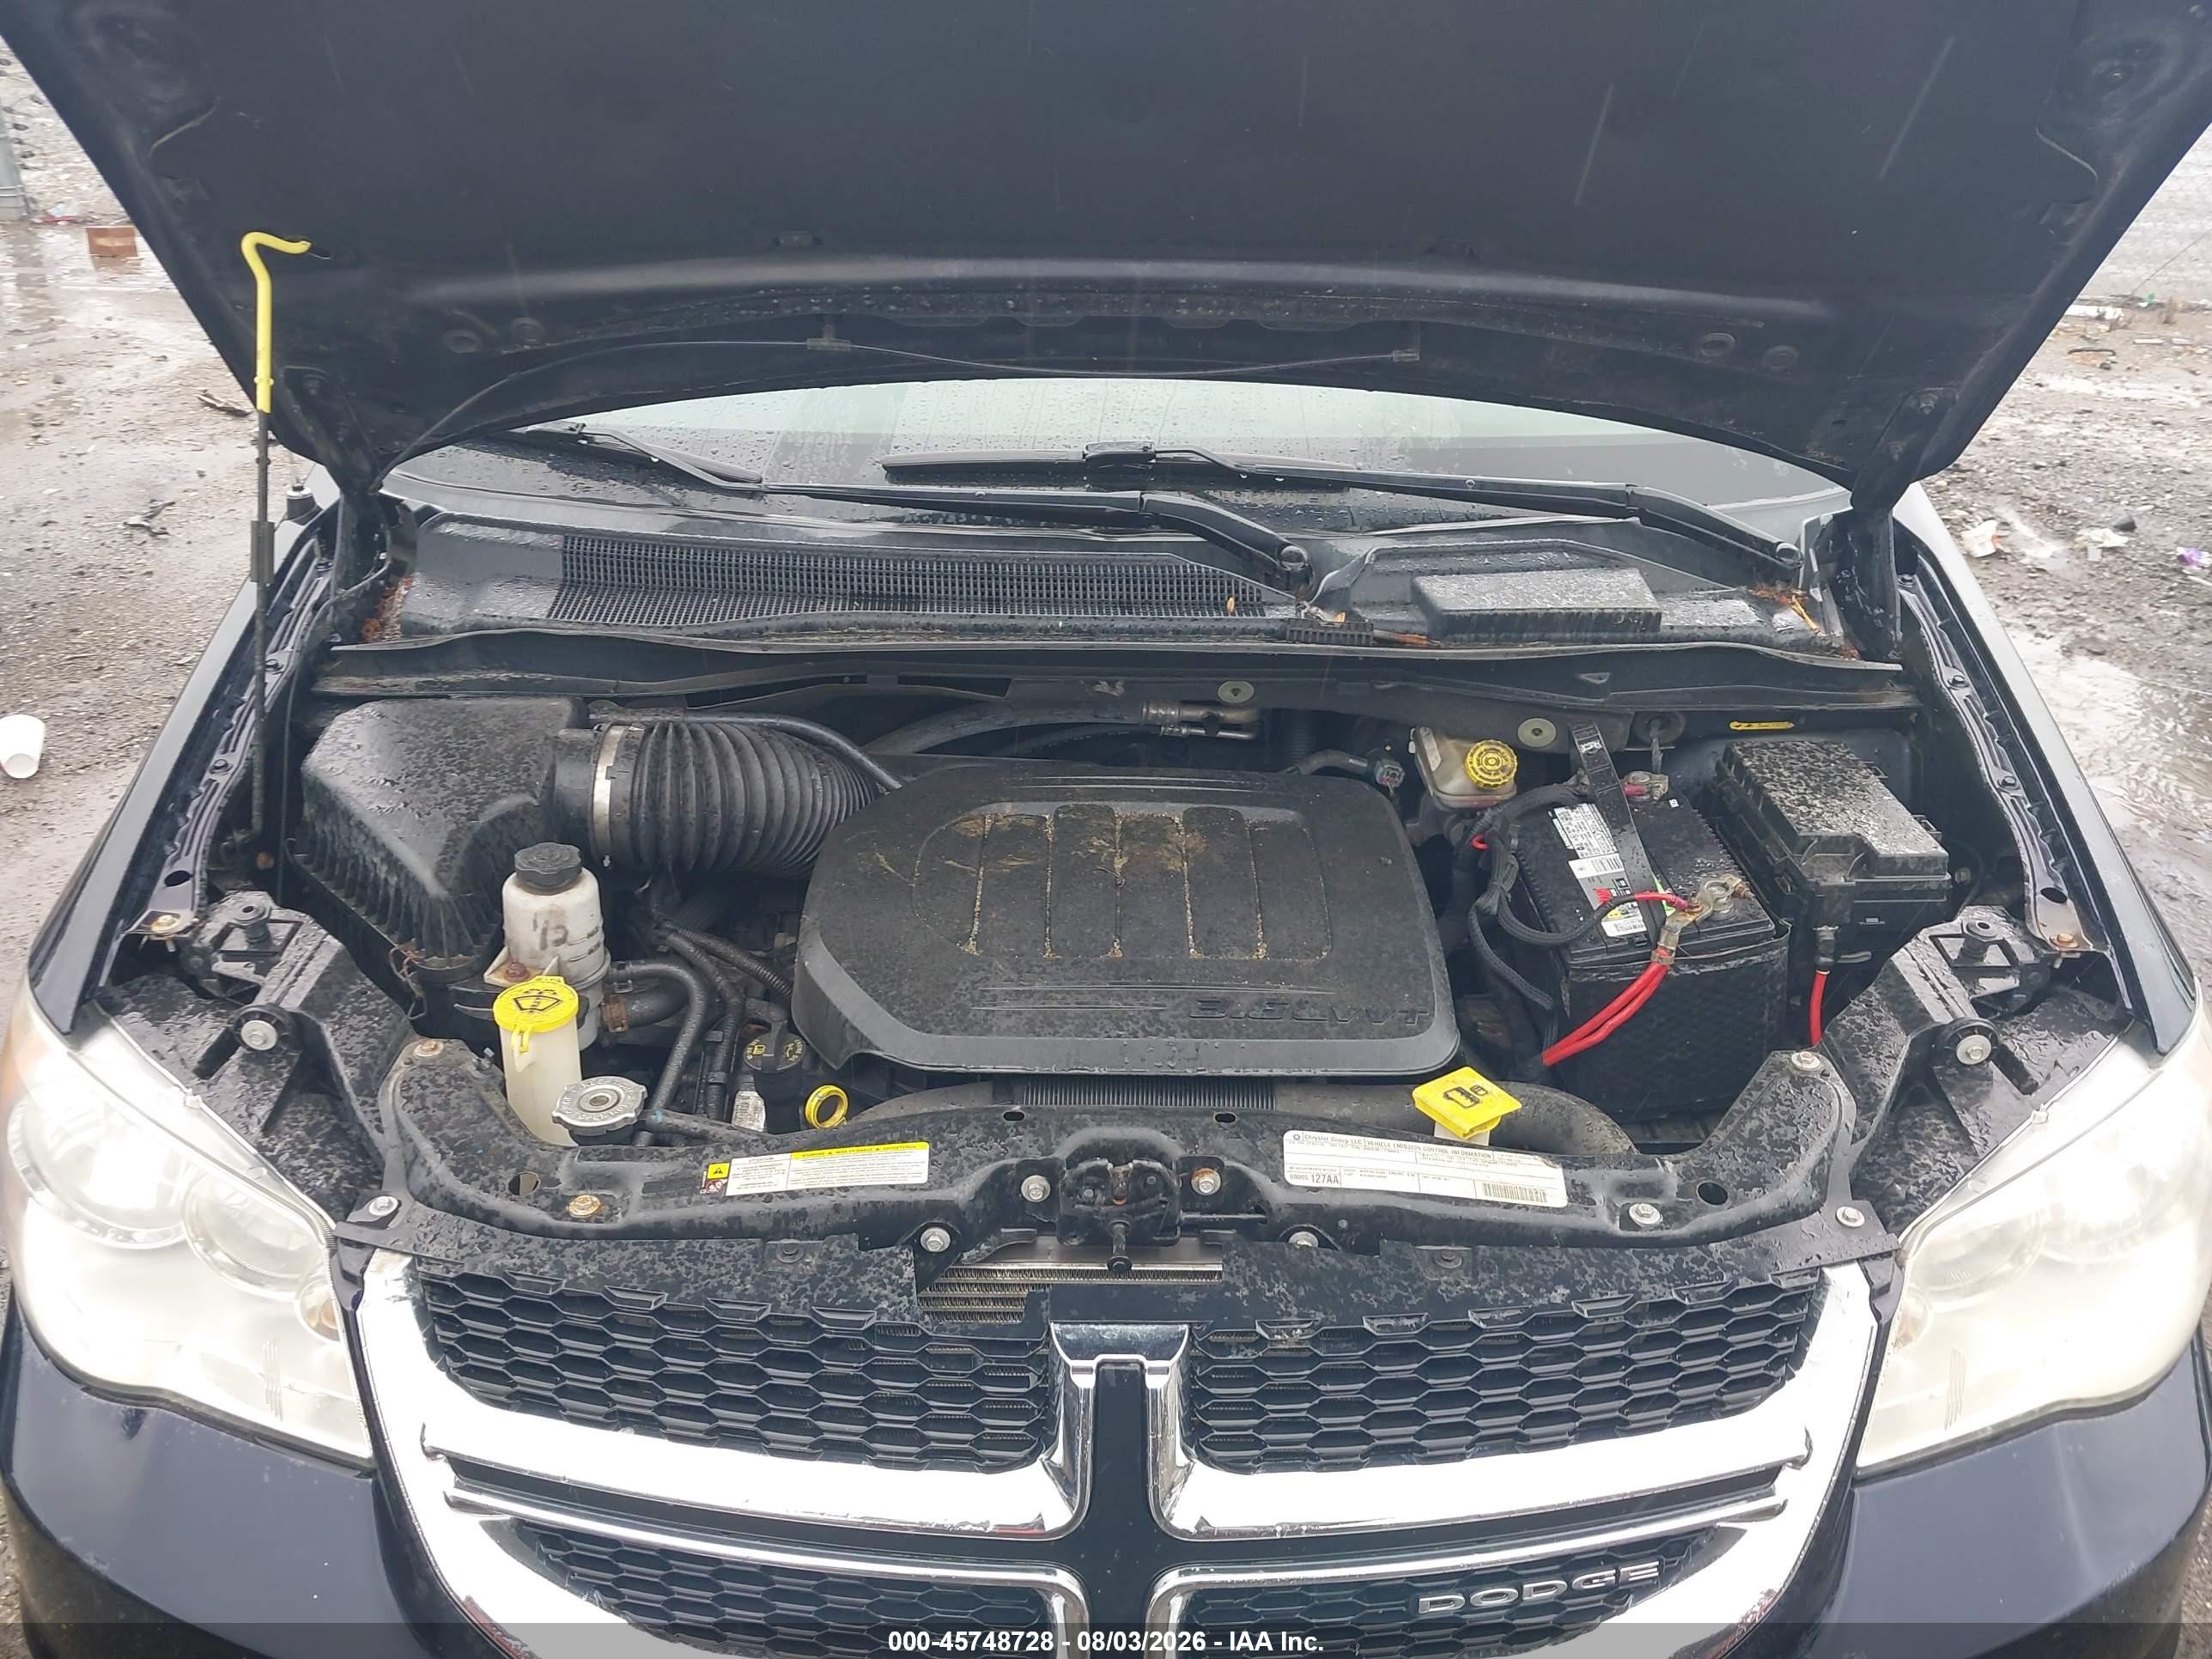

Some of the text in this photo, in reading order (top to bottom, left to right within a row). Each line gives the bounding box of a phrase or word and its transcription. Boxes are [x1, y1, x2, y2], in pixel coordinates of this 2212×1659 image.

[1331, 1136, 1349, 1145] Group
[1393, 1143, 1421, 1152] EMISSION
[1451, 1149, 1492, 1159] INFORMATION
[1311, 1174, 1340, 1184] 127AA
[1418, 1560, 1660, 1614] DODGE
